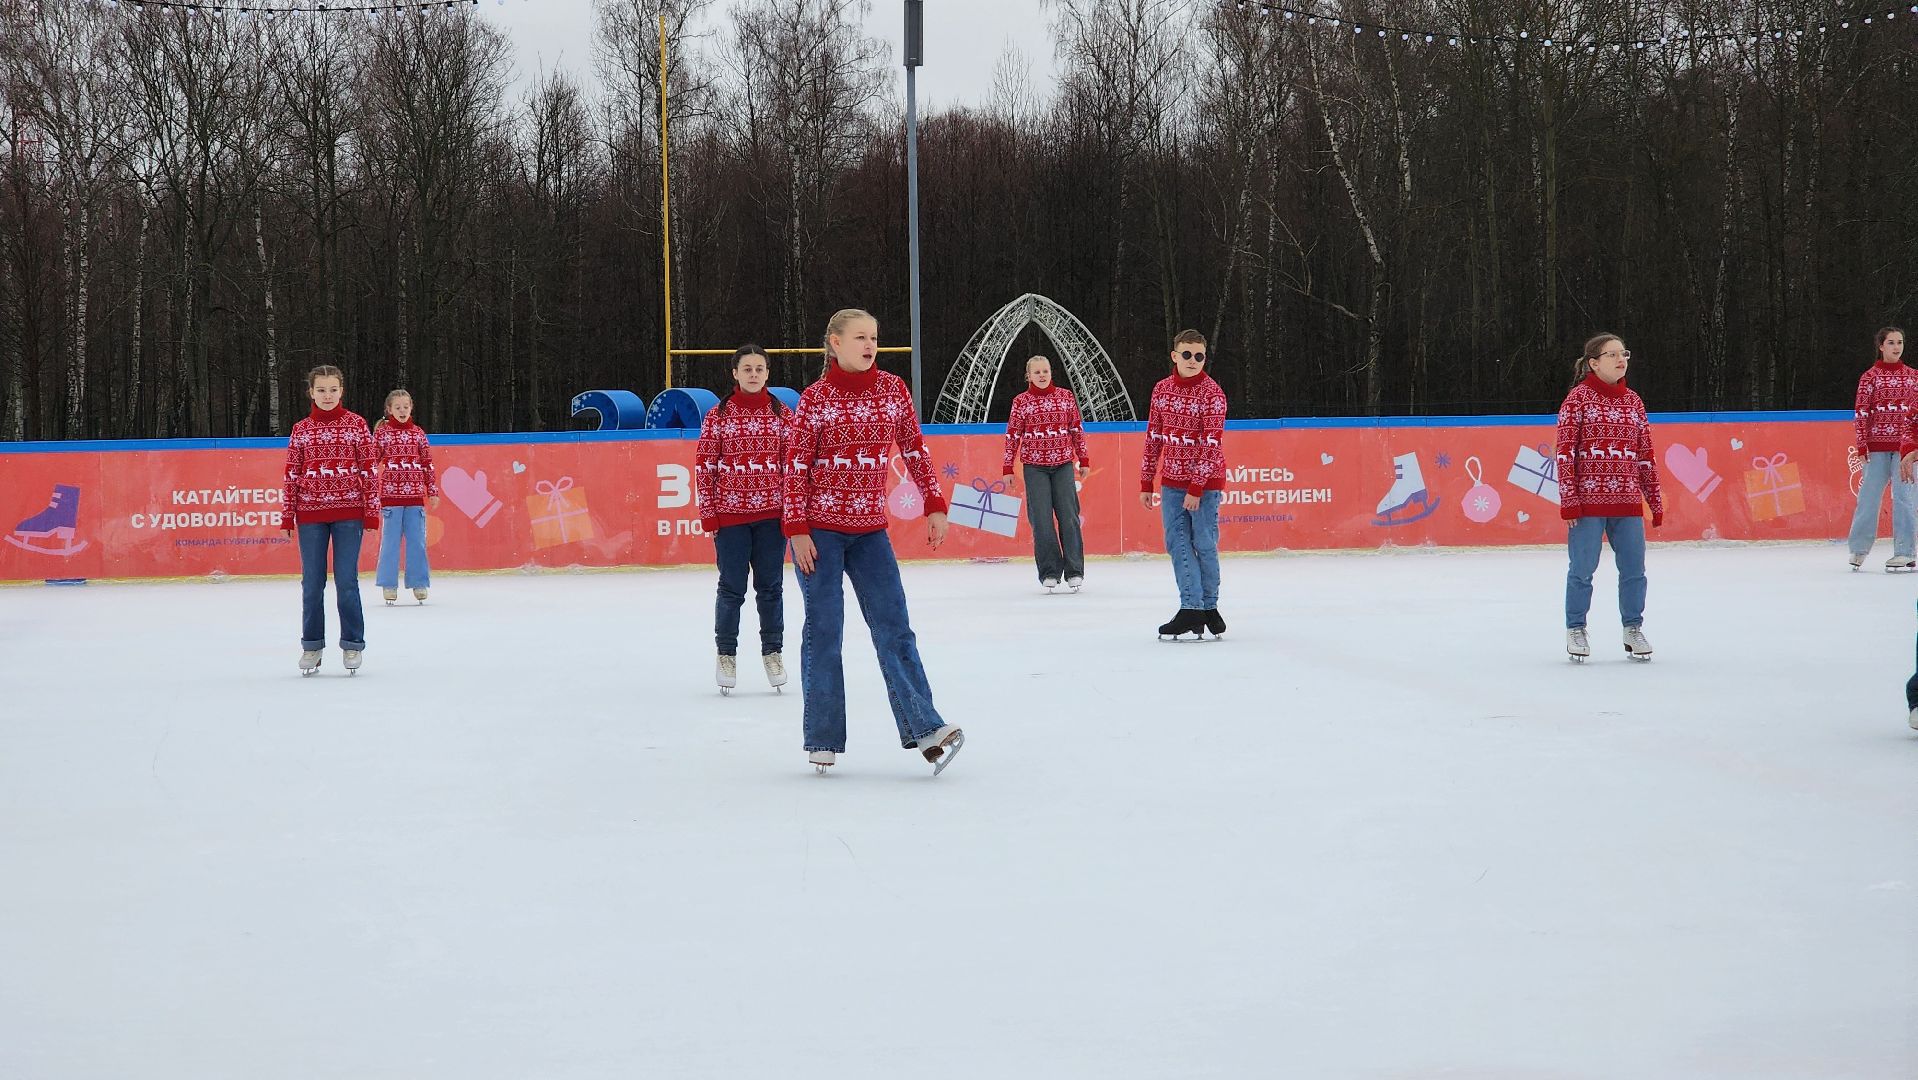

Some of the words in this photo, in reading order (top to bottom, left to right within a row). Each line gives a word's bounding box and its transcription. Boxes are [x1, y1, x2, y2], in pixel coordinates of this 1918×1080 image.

[1226, 464, 1294, 483] АЙТЕСЬ
[1220, 488, 1332, 505] ОЛЬСТВИЕМ!
[131, 514, 145, 528] С
[148, 511, 282, 530] УДОВОЛЬСТВ
[657, 520, 671, 536] В
[676, 519, 710, 538] ПО
[175, 538, 222, 547] КОМАНДА
